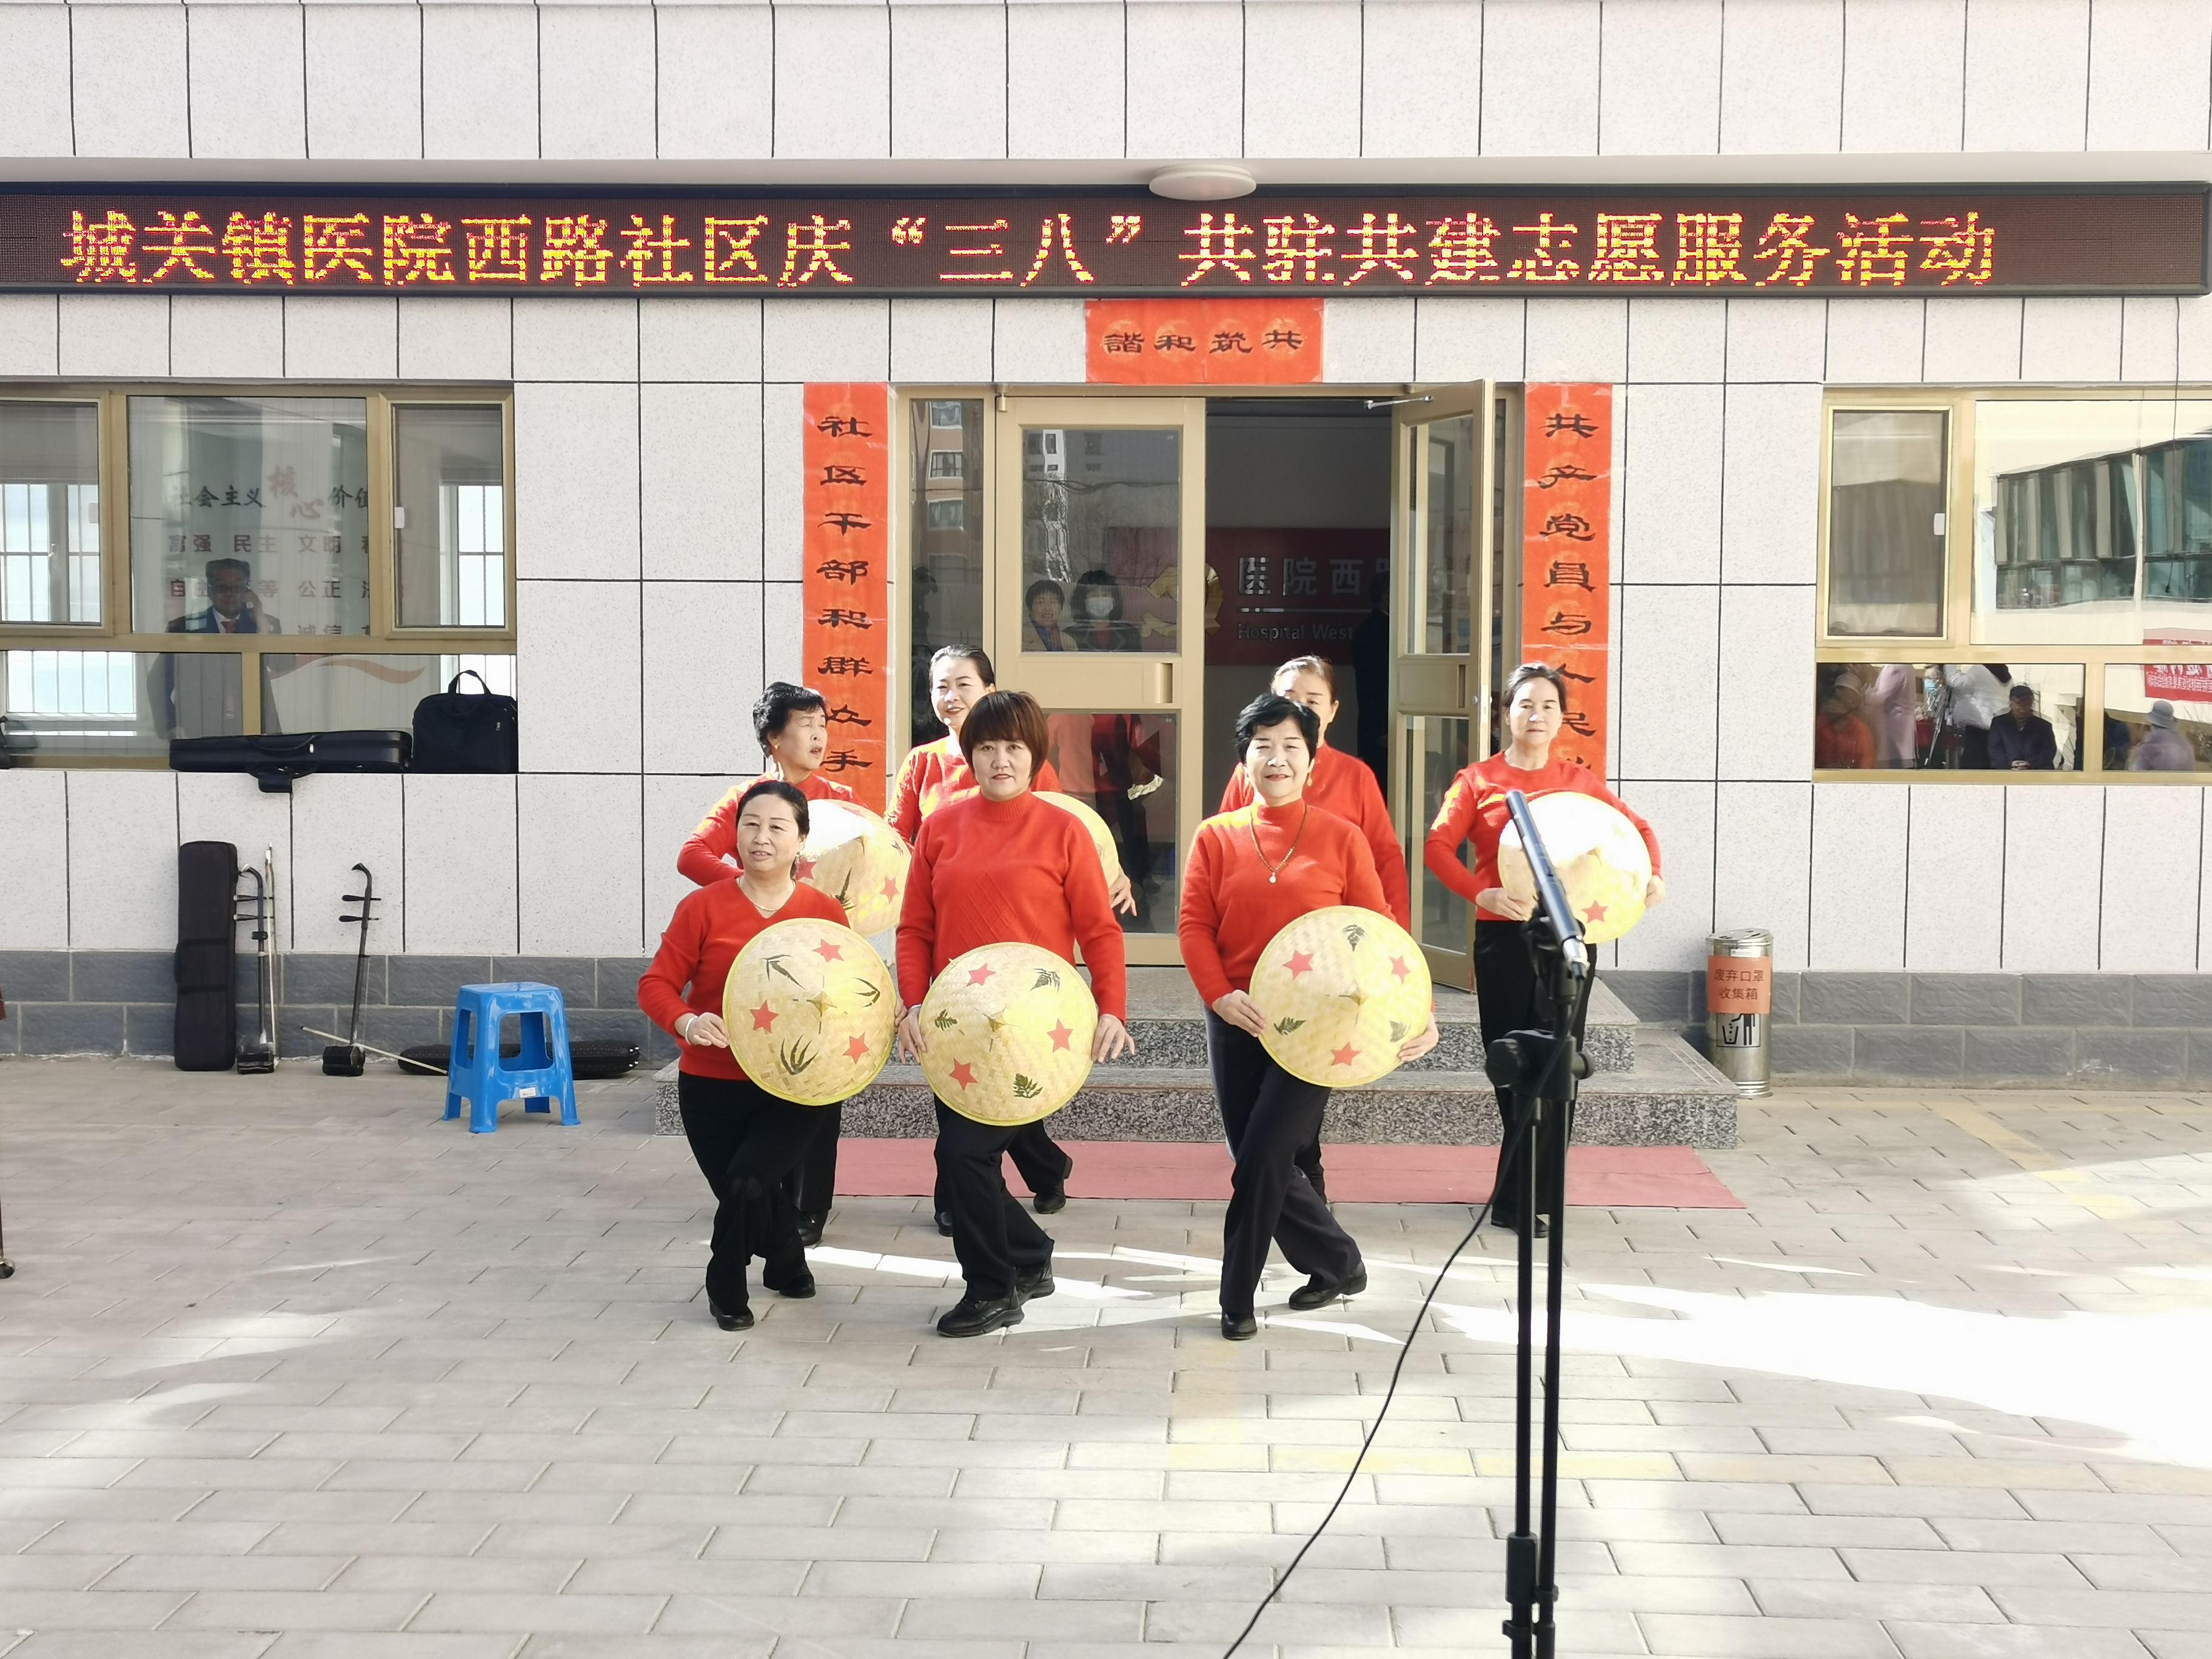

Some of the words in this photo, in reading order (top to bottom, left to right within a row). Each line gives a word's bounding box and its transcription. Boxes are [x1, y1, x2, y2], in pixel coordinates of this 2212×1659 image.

[1238, 557, 1390, 596] 医院西
[1238, 623, 1304, 642] Hospital
[1312, 624, 1355, 640] West
[1714, 968, 1765, 983] 废弃口罩
[1718, 987, 1758, 1000] 收集箱
